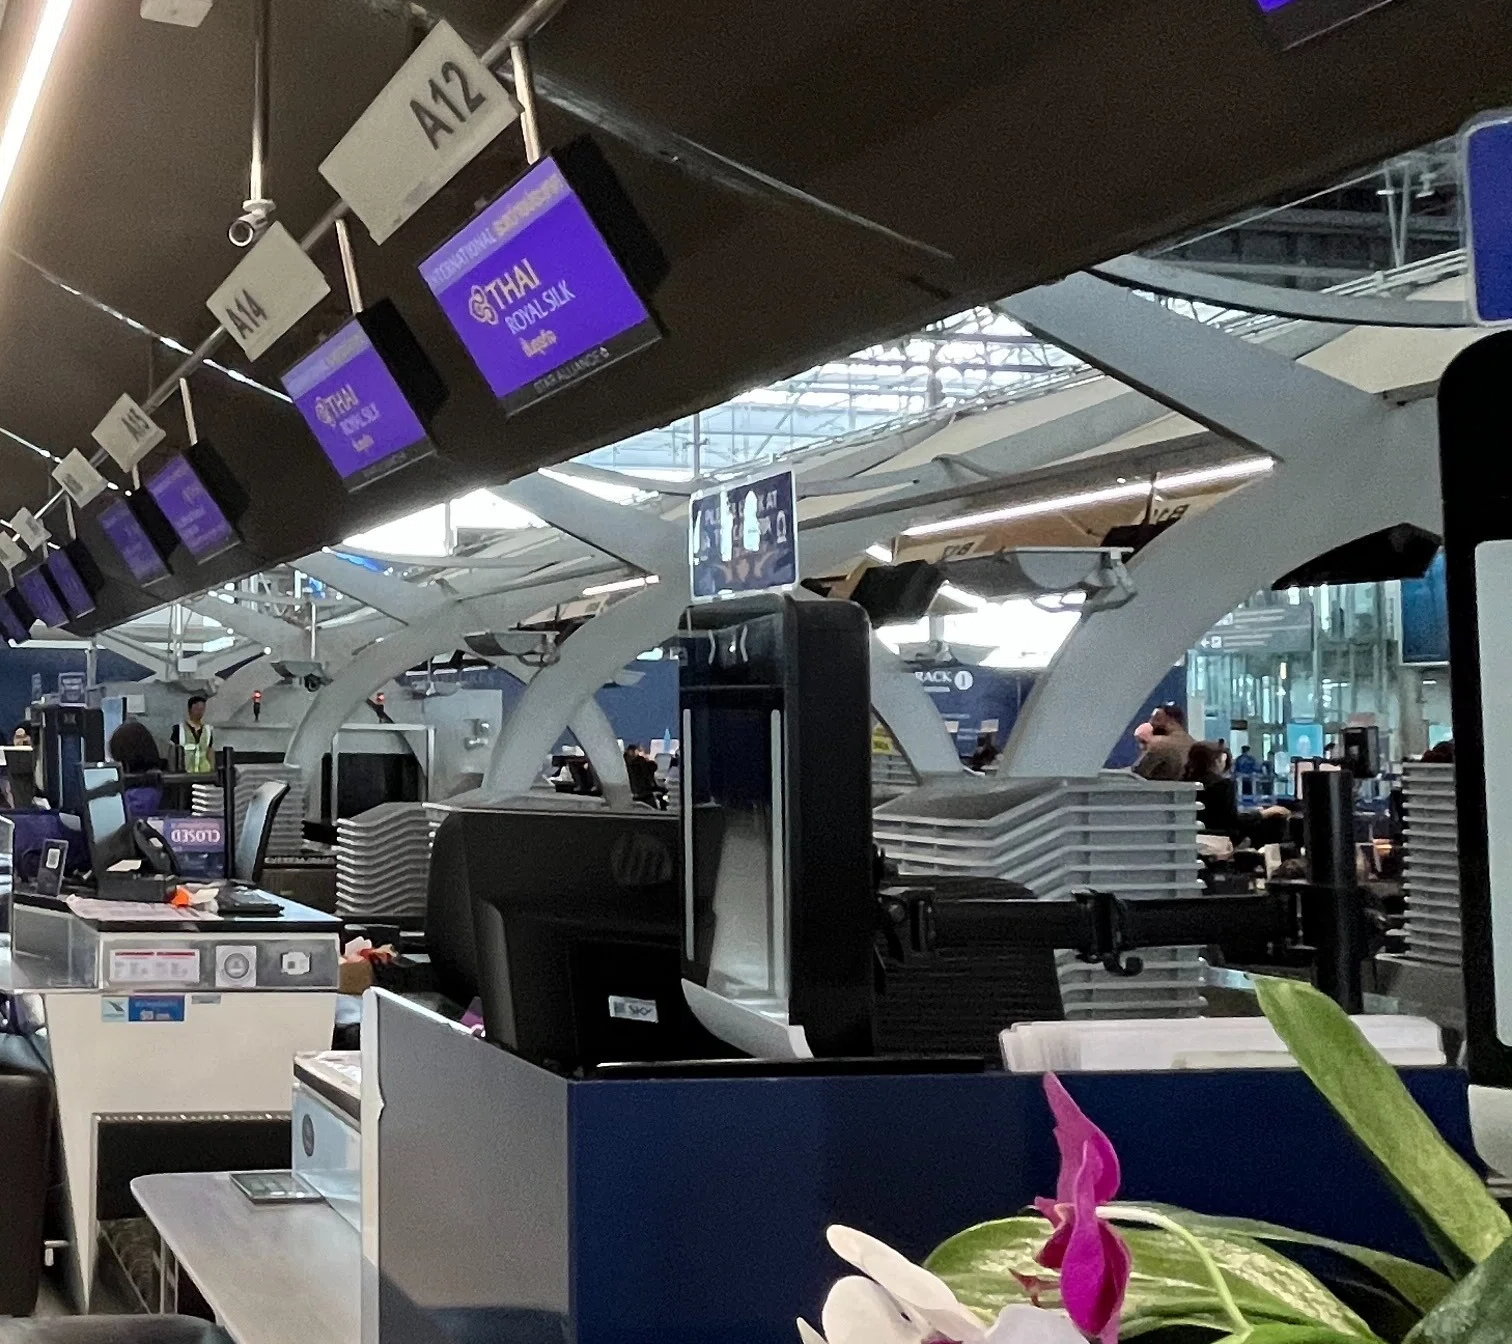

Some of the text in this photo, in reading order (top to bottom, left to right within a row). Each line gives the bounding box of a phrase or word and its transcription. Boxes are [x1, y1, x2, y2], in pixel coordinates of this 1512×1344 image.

[409, 60, 487, 151] A12
[484, 257, 541, 311] THAI
[504, 279, 576, 335] ROYAL SILK
[225, 288, 268, 340] A14
